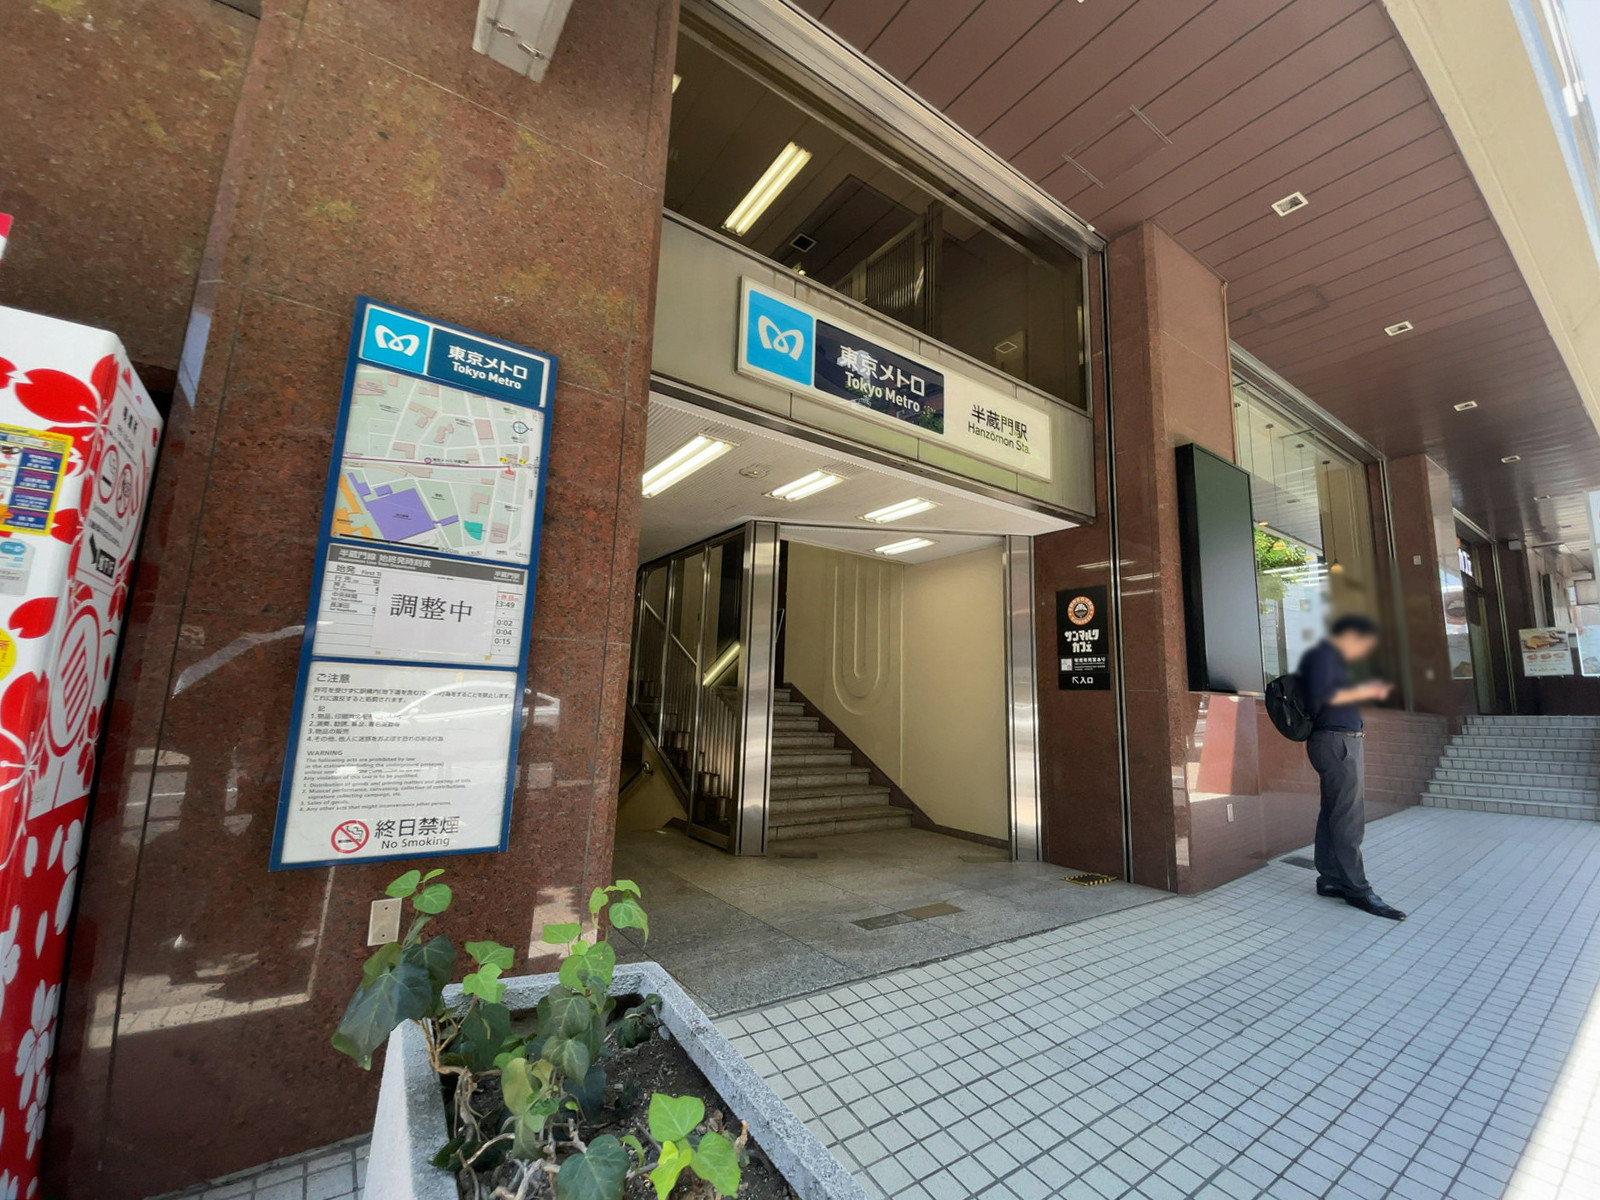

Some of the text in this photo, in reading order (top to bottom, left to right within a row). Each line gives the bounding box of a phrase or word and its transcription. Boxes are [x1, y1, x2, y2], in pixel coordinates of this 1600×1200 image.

[448, 344, 528, 380] 東京メトロ
[451, 361, 522, 390] Tokyo Metro
[837, 344, 925, 397] 東京メトロ
[844, 371, 920, 413] Tokyo Metro
[971, 404, 1028, 442] 半蔵門駅
[1016, 438, 1031, 455] Sta.
[391, 593, 472, 623] 調整中
[496, 619, 513, 627] 0:02
[495, 628, 512, 636] 0:04
[1064, 629, 1099, 641] サンマルク
[494, 637, 511, 645] 0:15
[1072, 641, 1093, 653] カフェ
[316, 672, 351, 684] ご注意
[1080, 676, 1094, 684] 入口
[374, 816, 460, 839] 終日禁煙
[381, 837, 450, 850] No Smoking
